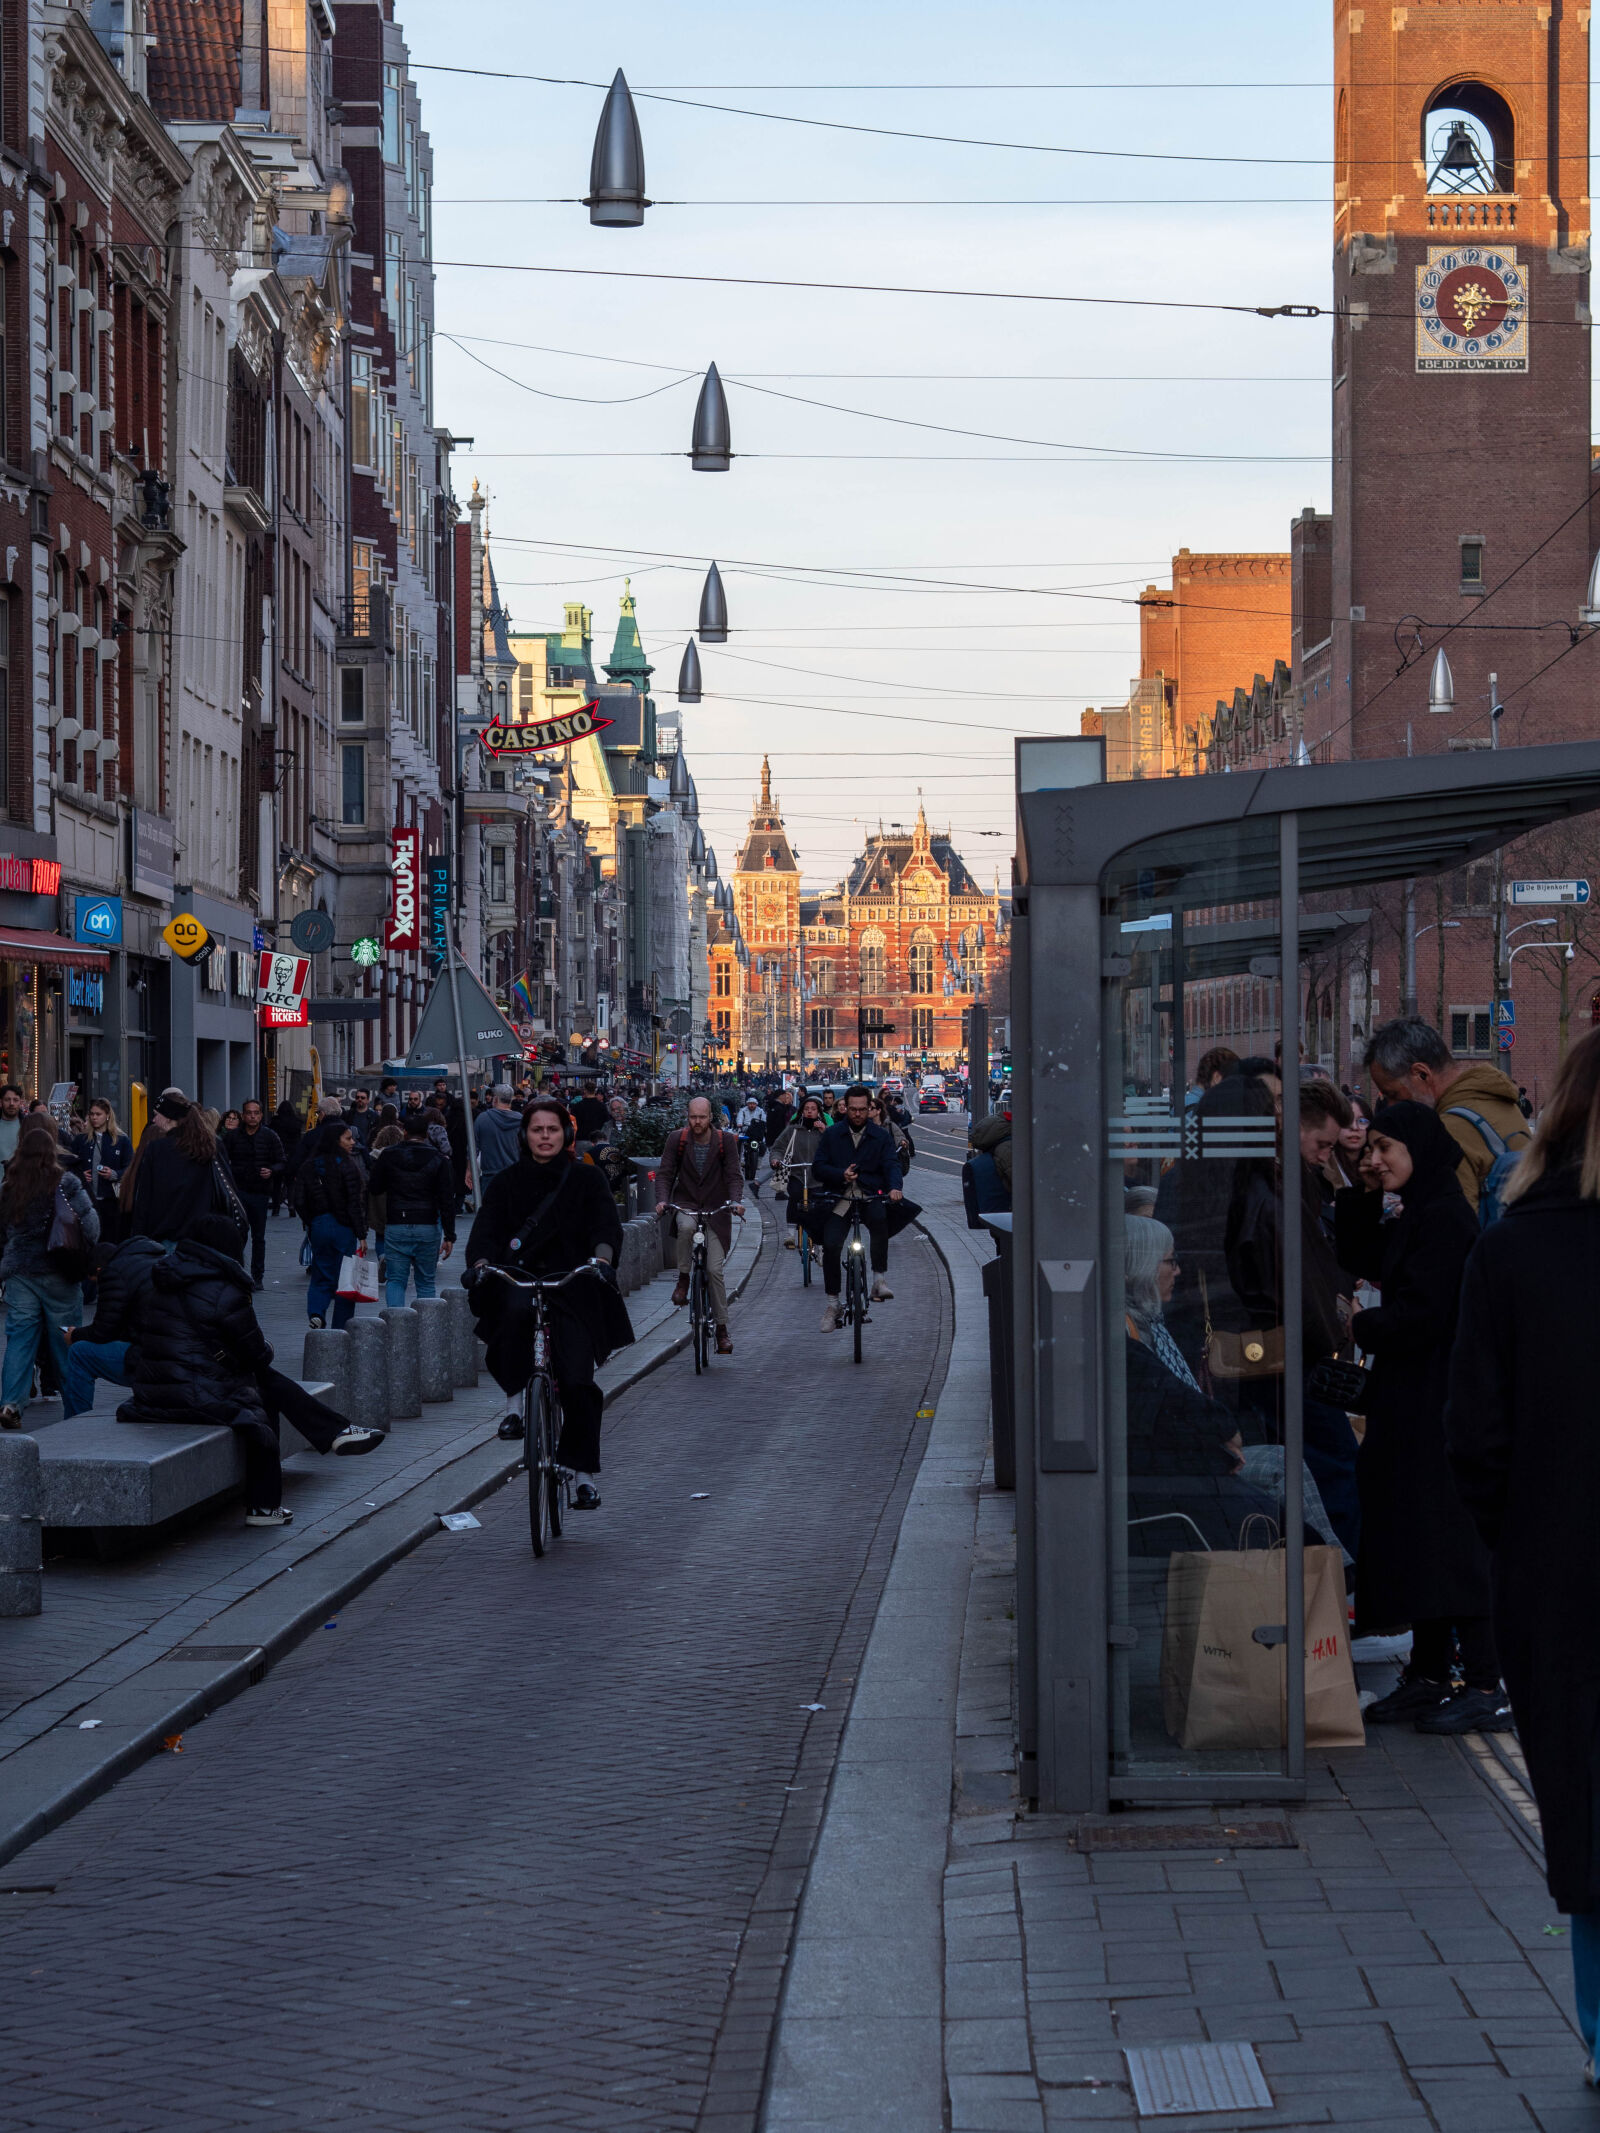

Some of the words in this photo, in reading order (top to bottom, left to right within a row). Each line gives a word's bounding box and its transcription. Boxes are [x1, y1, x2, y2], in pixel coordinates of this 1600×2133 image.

[1444, 256, 1454, 270] 11
[1466, 250, 1478, 263] 12
[1427, 272, 1438, 287] 10
[1507, 273, 1516, 286] 2
[1423, 295, 1432, 308] 9
[1428, 318, 1438, 331] 8
[1446, 334, 1454, 348] 7
[1467, 339, 1478, 354] 6
[1490, 334, 1498, 347] 5
[1425, 360, 1460, 369] BEIDT
[1468, 360, 1486, 368] UW
[1494, 360, 1518, 368] TYD
[486, 712, 592, 749] CASINO
[1140, 704, 1152, 761] BEURS
[32, 859, 61, 896] TODAY
[433, 869, 447, 963] PRIMARK
[194, 946, 212, 962] cash
[262, 992, 294, 1006] KFC
[271, 1012, 302, 1022] TICKETS
[477, 1030, 503, 1040] BUKO
[1203, 1645, 1232, 1659] WITH
[1312, 1635, 1338, 1661] H&M
